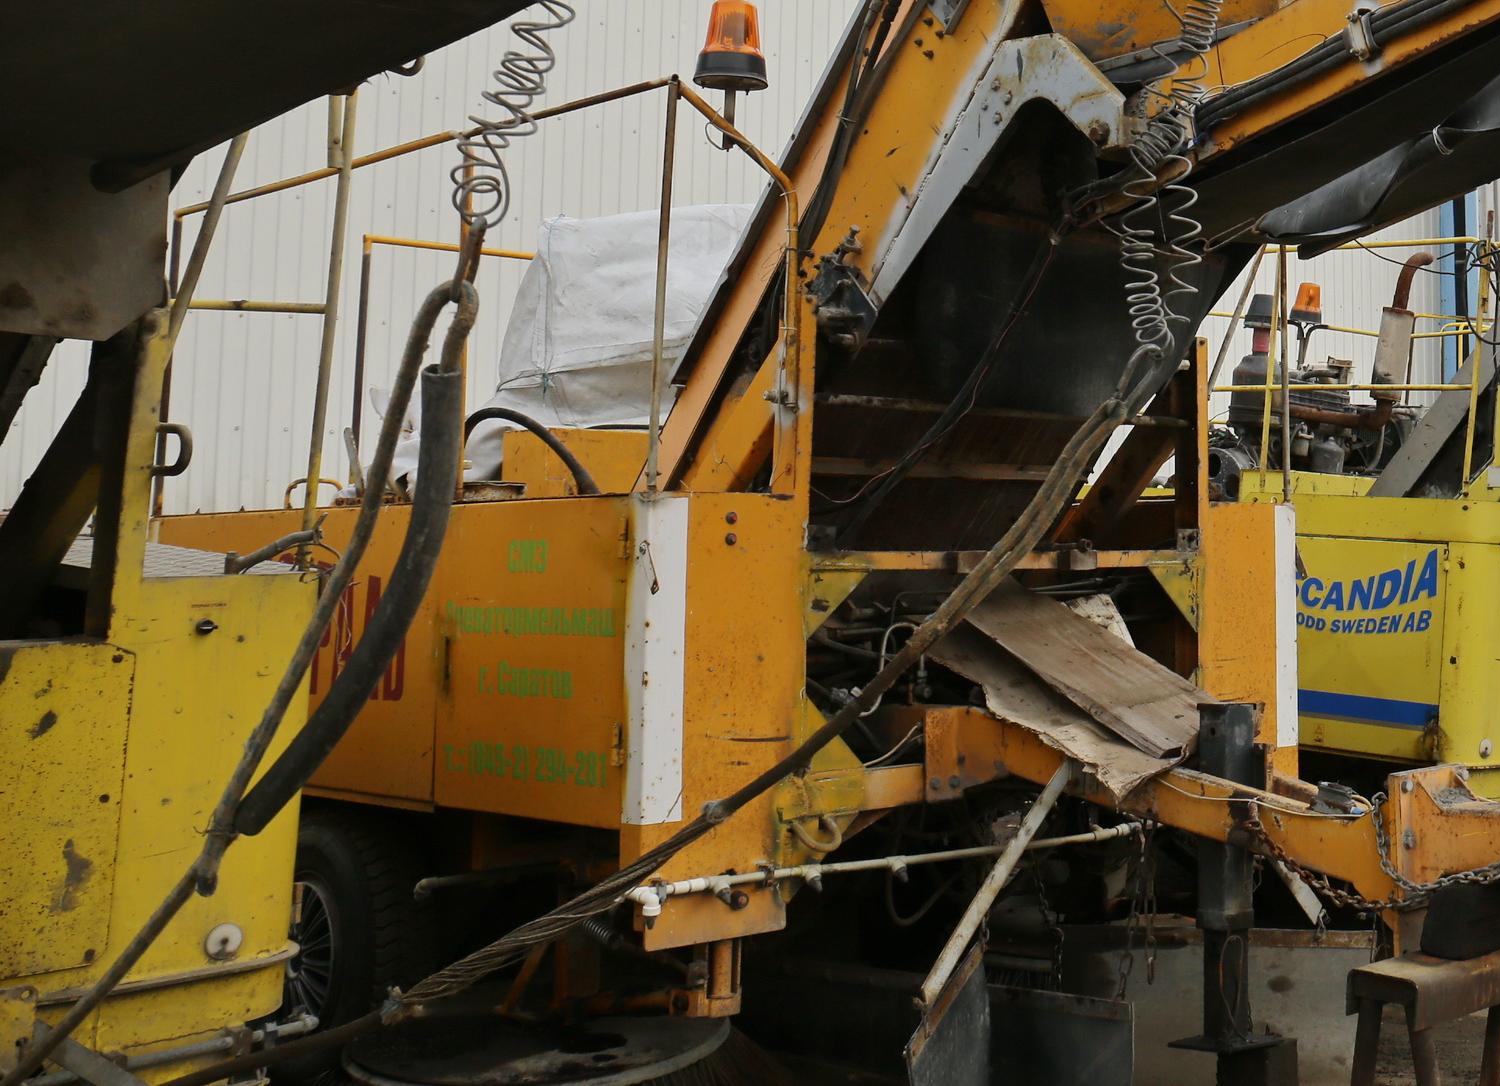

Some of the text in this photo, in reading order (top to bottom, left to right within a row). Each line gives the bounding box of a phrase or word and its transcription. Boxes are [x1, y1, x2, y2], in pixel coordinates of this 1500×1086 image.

[1297, 609, 1433, 634] ODD SWEDEN AB
